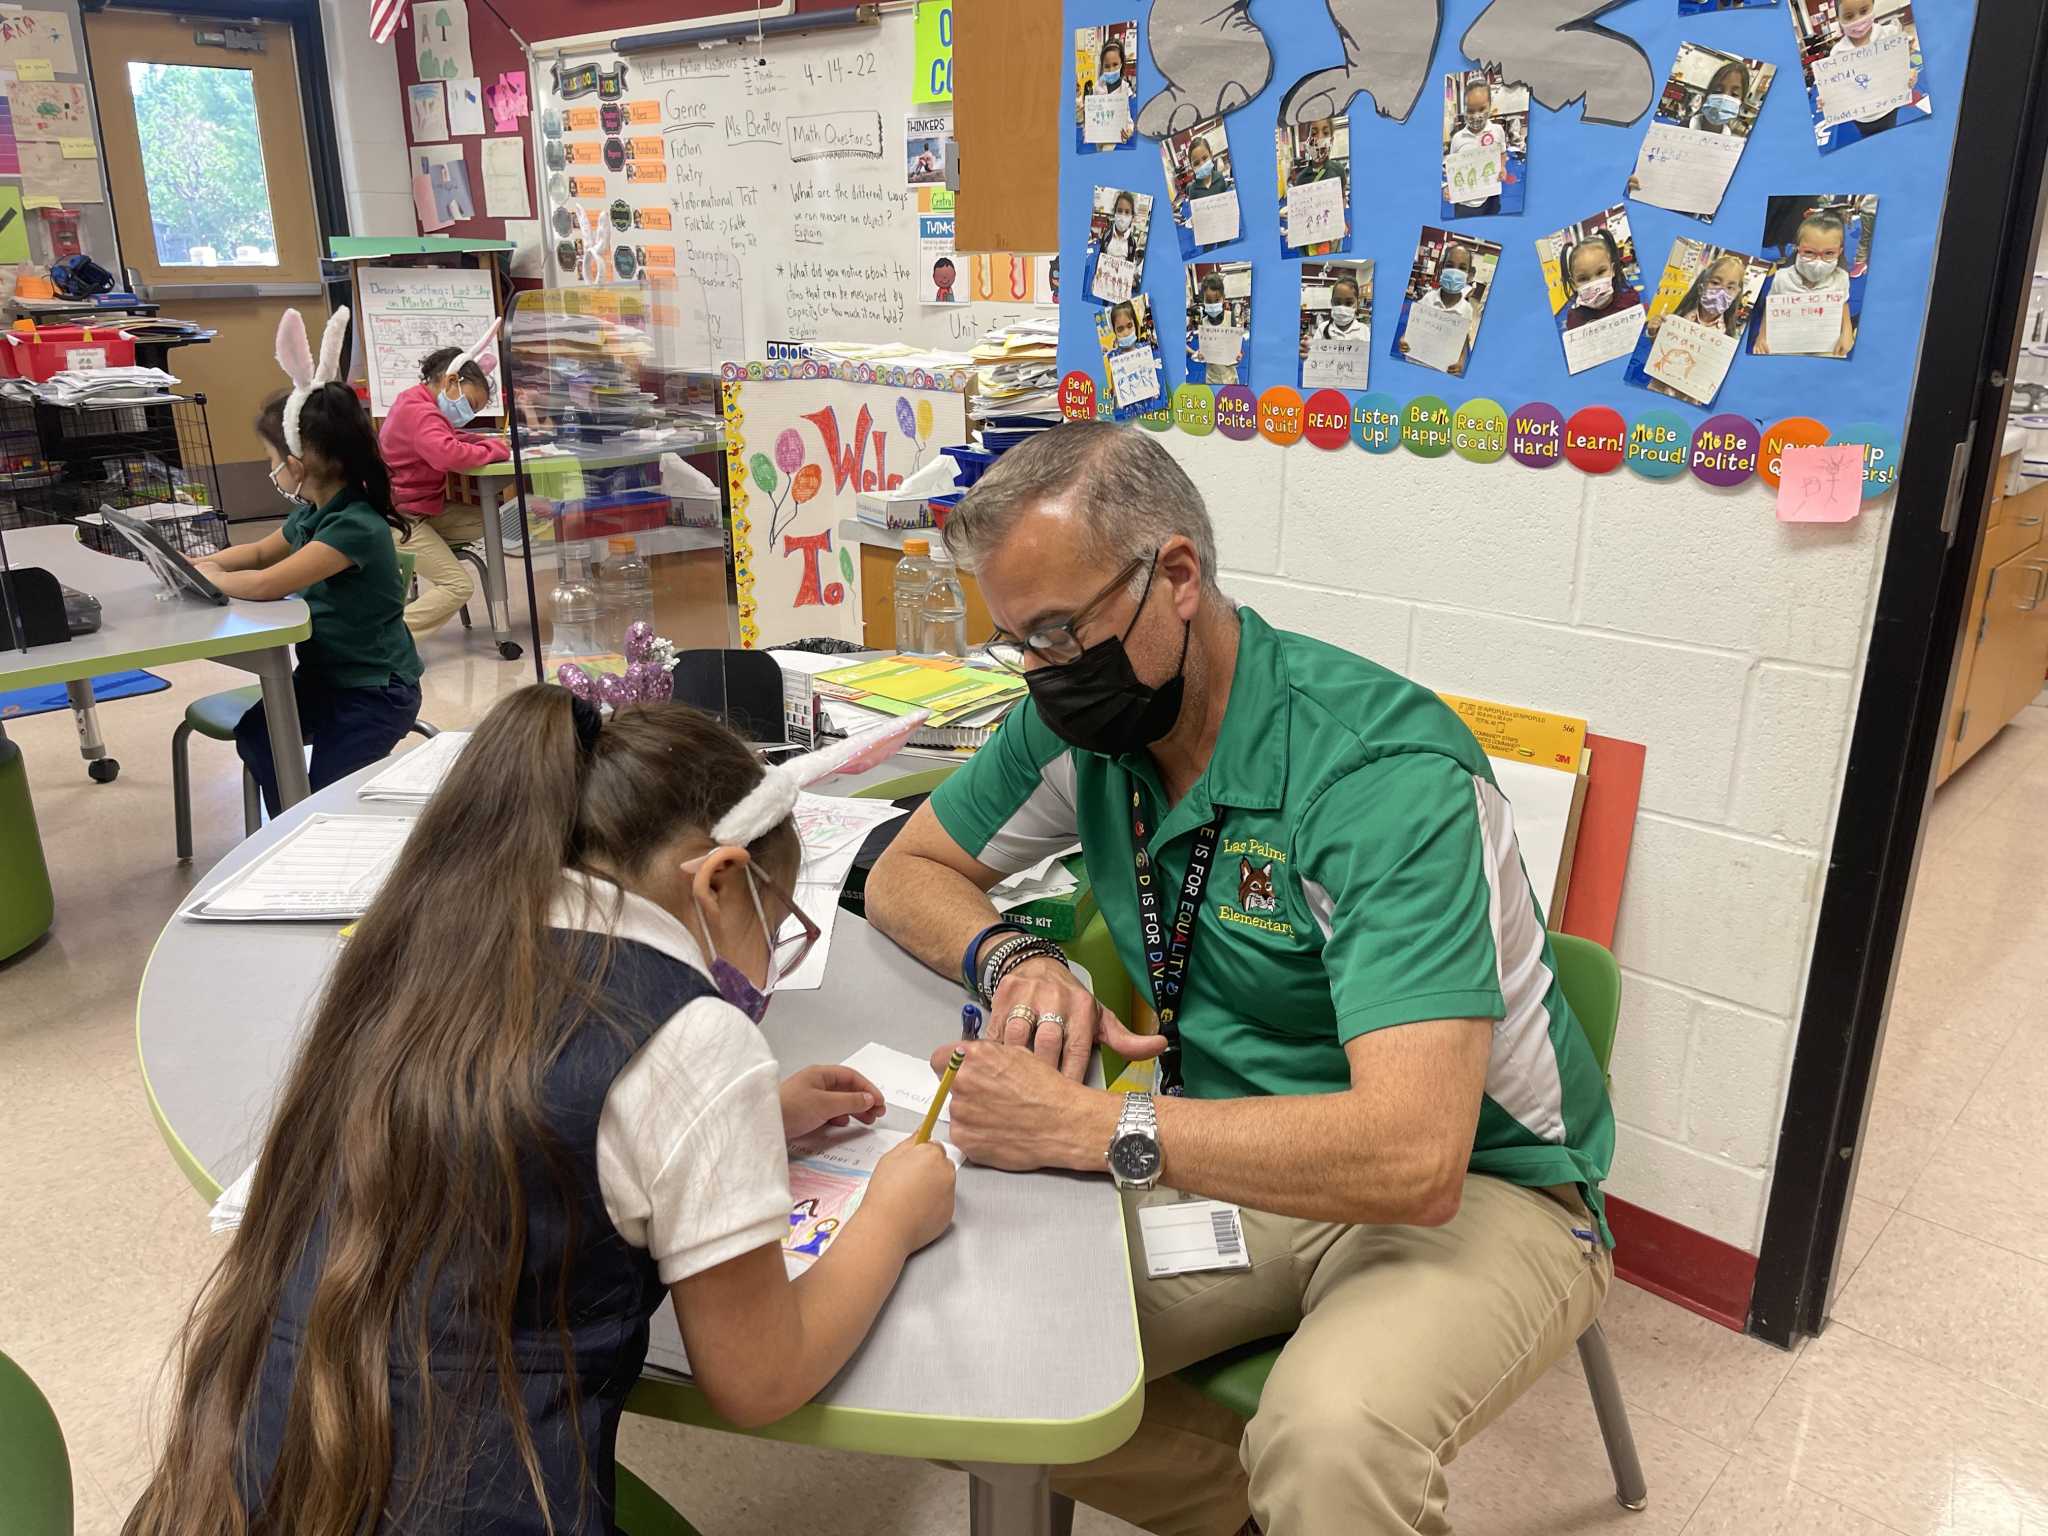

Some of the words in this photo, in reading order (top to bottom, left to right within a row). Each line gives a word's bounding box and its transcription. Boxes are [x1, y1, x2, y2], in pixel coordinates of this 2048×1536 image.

[665, 88, 707, 121] Genre
[745, 109, 782, 138] Bentley
[907, 118, 945, 132] THINKERS
[792, 122, 821, 144] Math
[824, 123, 873, 147] Questions
[670, 138, 703, 159] Fiction
[676, 162, 704, 188] Poetry
[789, 178, 815, 203] What
[835, 182, 849, 200] the
[788, 260, 809, 280] What
[811, 261, 822, 279] did
[865, 263, 888, 281] about
[893, 260, 912, 281] the
[949, 312, 979, 340] Unit
[1068, 377, 1081, 390] Be
[1065, 391, 1089, 406] Your
[1180, 394, 1207, 408] Take
[1235, 399, 1250, 412] Be
[1065, 405, 1091, 420] Best!
[1177, 409, 1213, 426] Turns!
[1262, 401, 1301, 418] Never
[1354, 407, 1399, 426] Listen
[1410, 406, 1429, 423] Be
[1217, 412, 1257, 429] Polite!
[1264, 418, 1298, 434] Quit!
[1308, 412, 1348, 430] READ!
[1456, 414, 1505, 433] Reach
[1516, 417, 1560, 437] Work
[1362, 427, 1389, 448] Up!
[1402, 425, 1451, 447] Happy!
[1456, 433, 1504, 451] Goals!
[1566, 430, 1625, 452] Learn!
[1655, 426, 1678, 443] Be
[1724, 433, 1748, 451] Be
[1513, 437, 1559, 458] Hard!
[1628, 443, 1688, 465] Proud!
[1692, 451, 1756, 472] Polite!
[783, 528, 845, 609] To
[1554, 752, 1571, 765] 3M
[1200, 826, 1215, 839] E
[1195, 844, 1211, 859] IS
[1222, 838, 1247, 854] Las
[1139, 875, 1151, 886] D
[1184, 863, 1205, 897] FOR
[1141, 893, 1154, 907] IS
[1143, 912, 1161, 945] FOR
[1168, 900, 1195, 979] EQUALITY
